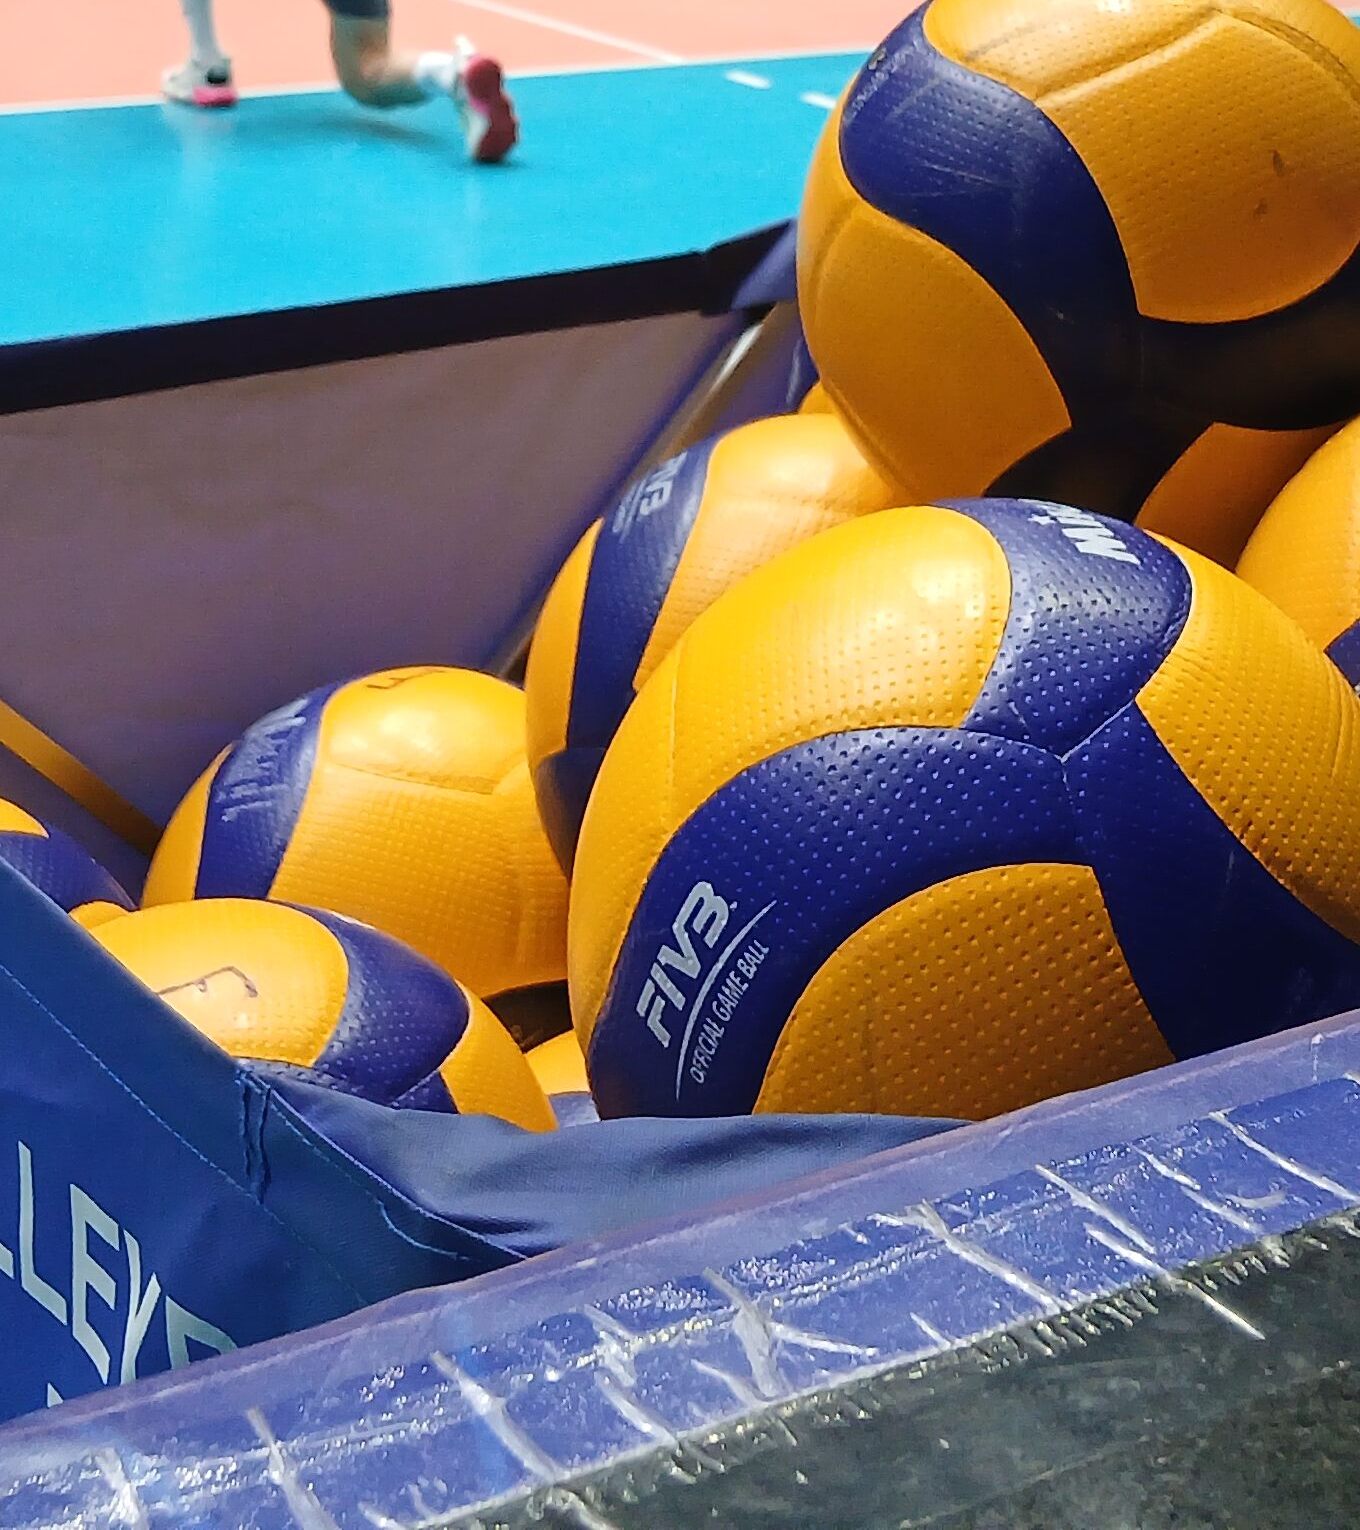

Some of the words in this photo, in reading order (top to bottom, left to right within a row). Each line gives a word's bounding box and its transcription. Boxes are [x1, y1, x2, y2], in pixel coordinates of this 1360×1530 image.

[636, 881, 730, 1048] FIVB
[690, 1017, 725, 1084] OFFICIAL
[712, 969, 749, 1022] GAME
[737, 939, 770, 980] BALL
